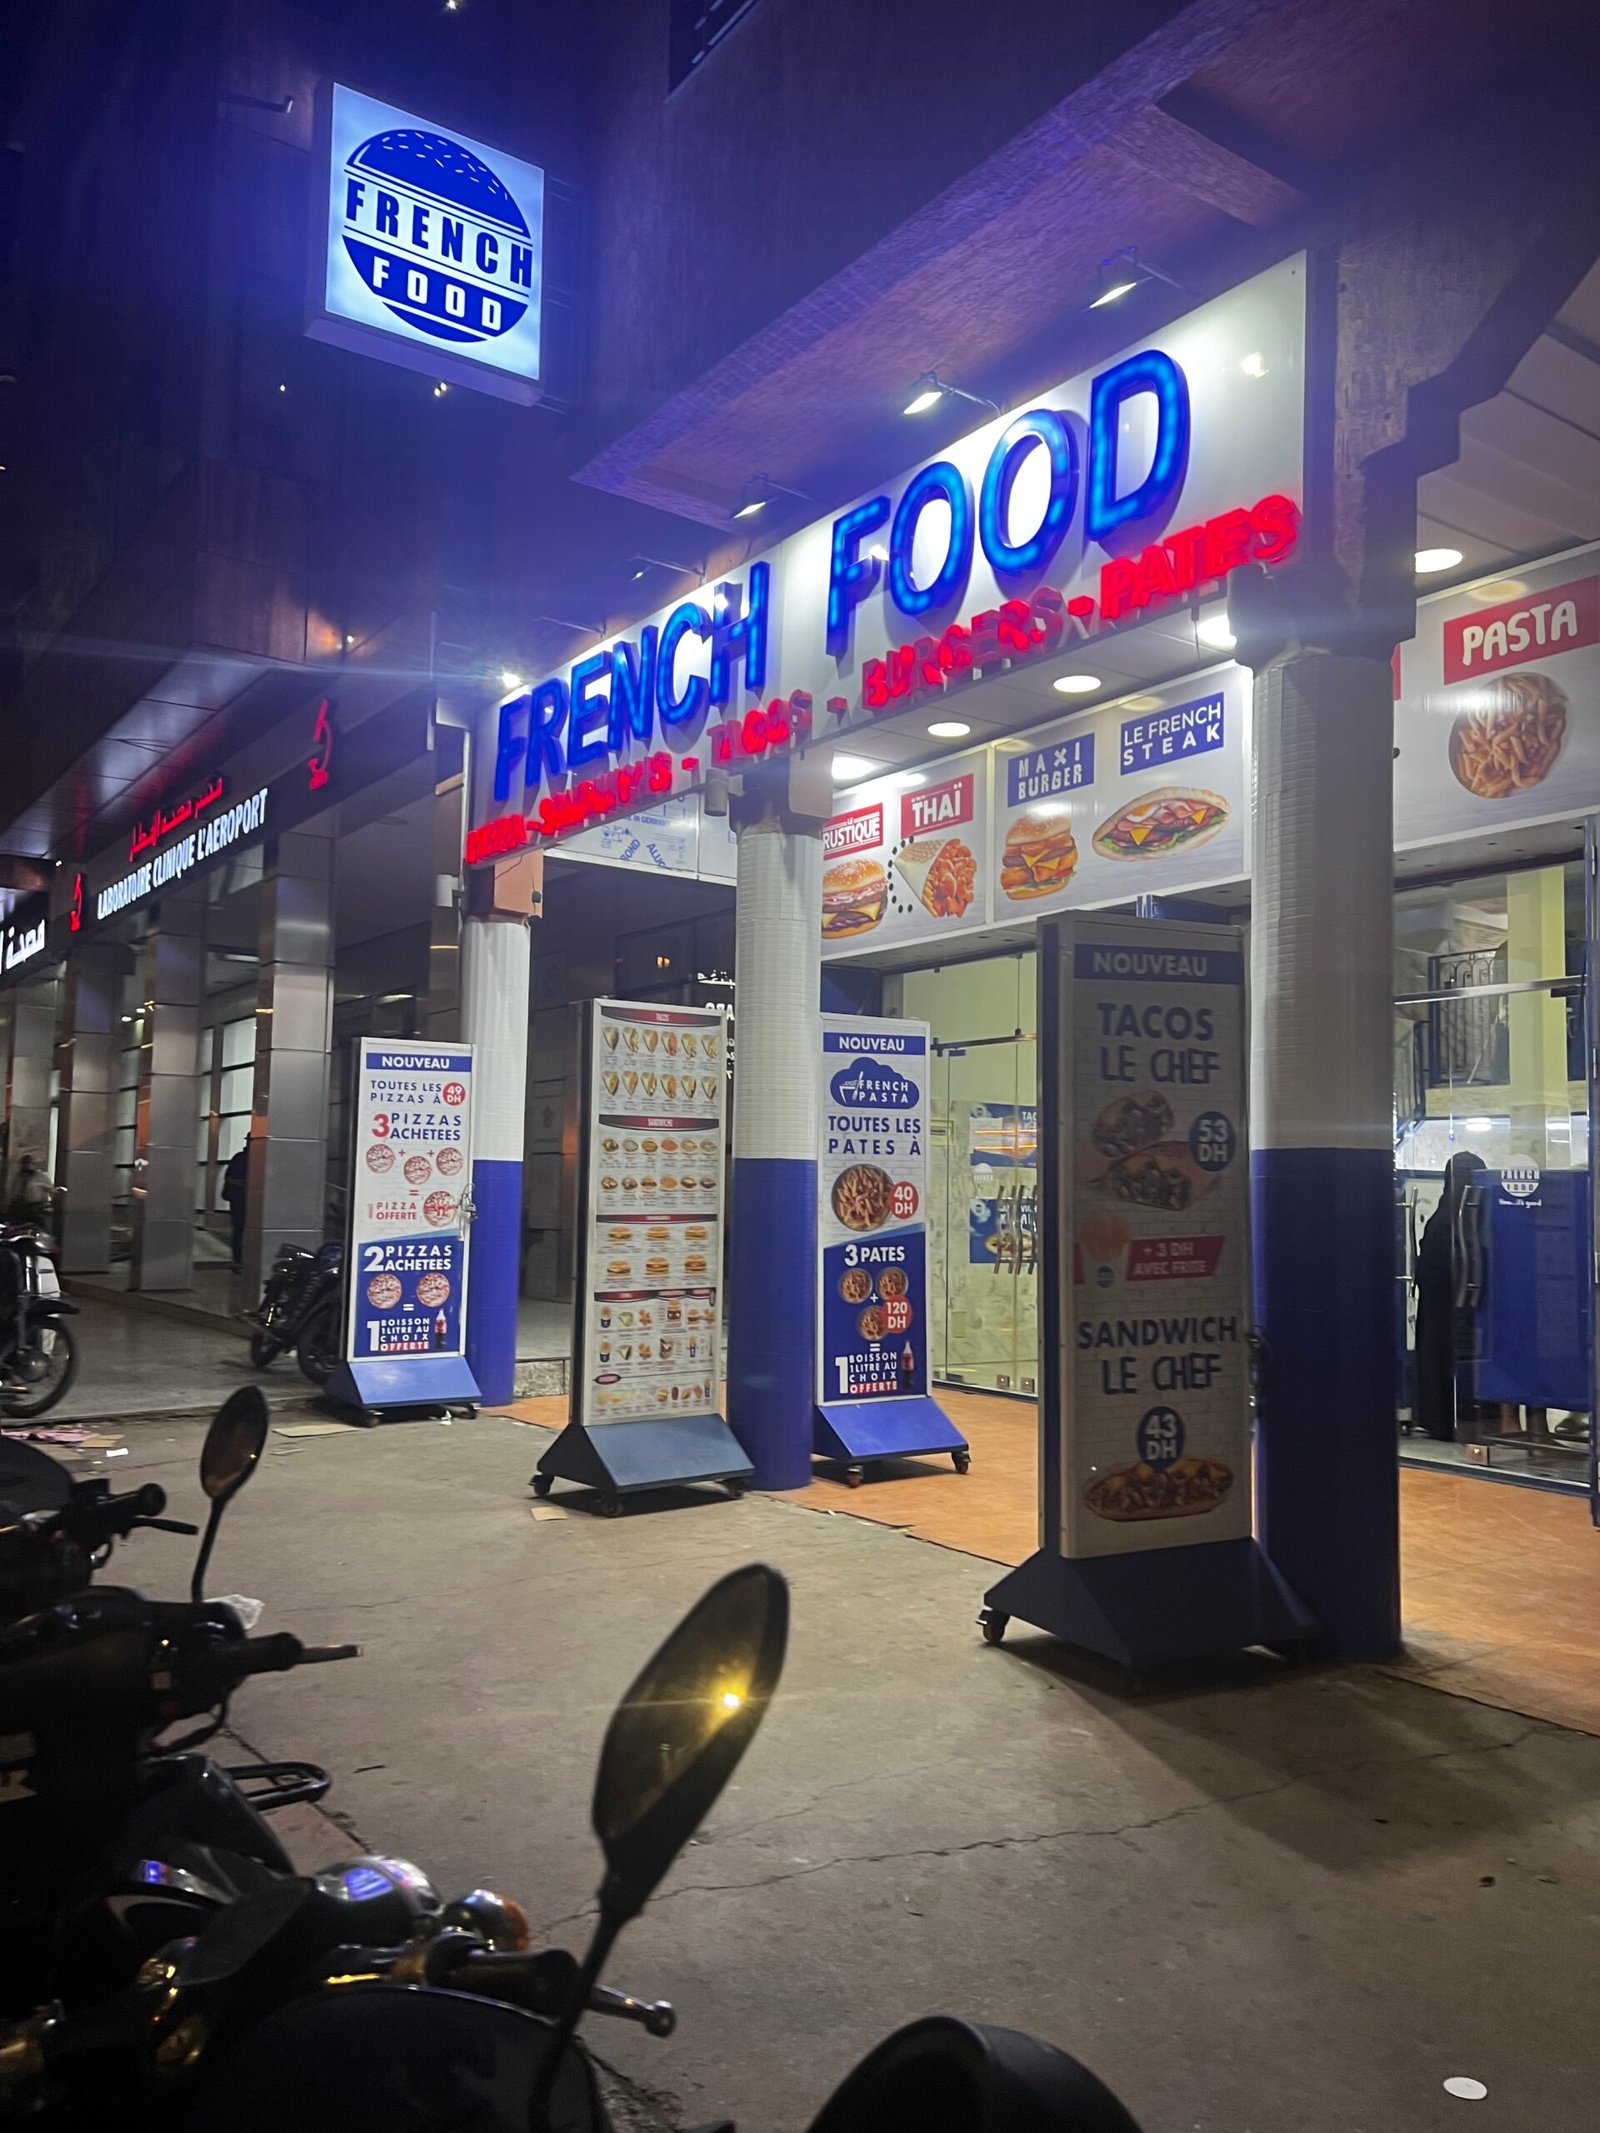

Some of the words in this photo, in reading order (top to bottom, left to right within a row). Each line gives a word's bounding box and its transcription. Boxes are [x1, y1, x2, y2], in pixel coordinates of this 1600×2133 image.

[346, 178, 533, 288] FRENCH
[373, 256, 502, 331] FOOD
[495, 561, 770, 801] FRENCH
[826, 350, 1190, 658] FOOD
[862, 586, 1064, 710] BURGERS
[1100, 495, 1298, 620] PATES
[1463, 600, 1578, 667] PASTA
[1124, 727, 1144, 747] LE
[1148, 702, 1221, 740] FRENCH
[1123, 723, 1220, 766] STEAK
[1018, 742, 1080, 779] MAXI
[1018, 763, 1082, 800] BURGER
[912, 782, 962, 828] THAÏ
[823, 816, 880, 849] RUSTIQUE
[97, 862, 152, 920] LABORATOIRE
[153, 834, 196, 887] CLINIQUE
[197, 788, 268, 860] L'AEROPORT
[1093, 952, 1208, 977] NOUVEAU
[1097, 1001, 1214, 1042] TACOS
[839, 1037, 905, 1051] NOUVEAU
[382, 1056, 450, 1069] NOUVEAU
[1101, 1045, 1136, 1082] LE
[1151, 1048, 1220, 1084] CHEF
[371, 1080, 417, 1091] TOUTES
[423, 1083, 441, 1092] LES
[859, 1079, 909, 1091] FRENCH
[371, 1093, 424, 1104] PIZZAS
[433, 1093, 441, 1104] À
[447, 1095, 462, 1104] DH
[859, 1091, 909, 1103] PASTA
[371, 1113, 390, 1137] 3
[391, 1112, 462, 1126] PIZZAS
[390, 1128, 461, 1141] ACHETEES
[828, 1115, 890, 1132] TOUTES
[896, 1118, 921, 1134] LES
[1198, 1119, 1228, 1142] 53
[828, 1138, 895, 1155] PATES
[910, 1136, 921, 1155] À
[1198, 1144, 1228, 1162] DH
[894, 1186, 913, 1201] 40
[376, 1211, 417, 1220] OFFERTE
[377, 1201, 417, 1210] PIZZA
[894, 1202, 913, 1214] DH
[364, 1246, 385, 1272] 2
[386, 1245, 452, 1257] PIZZAS
[385, 1259, 452, 1271] ACHETEES
[845, 1244, 858, 1266] 3
[861, 1246, 905, 1263] PATES
[886, 1301, 908, 1314] 120
[417, 1325, 430, 1333] AU
[888, 1316, 906, 1329] DH
[1077, 1316, 1237, 1349] SANDWICH
[367, 1320, 380, 1351] 1
[381, 1318, 430, 1327] BOISSON
[380, 1333, 429, 1342] CHOIX
[380, 1342, 429, 1351] OFFERTE
[835, 1356, 848, 1394] 1
[849, 1352, 897, 1363] BOISSON
[884, 1361, 897, 1370] AU
[1103, 1356, 1137, 1395] LE
[1152, 1353, 1222, 1392] CHEF
[849, 1371, 896, 1383] CHOIX
[850, 1381, 898, 1394] OFFERTE
[1145, 1413, 1177, 1439] 43
[1146, 1440, 1176, 1460] DH
